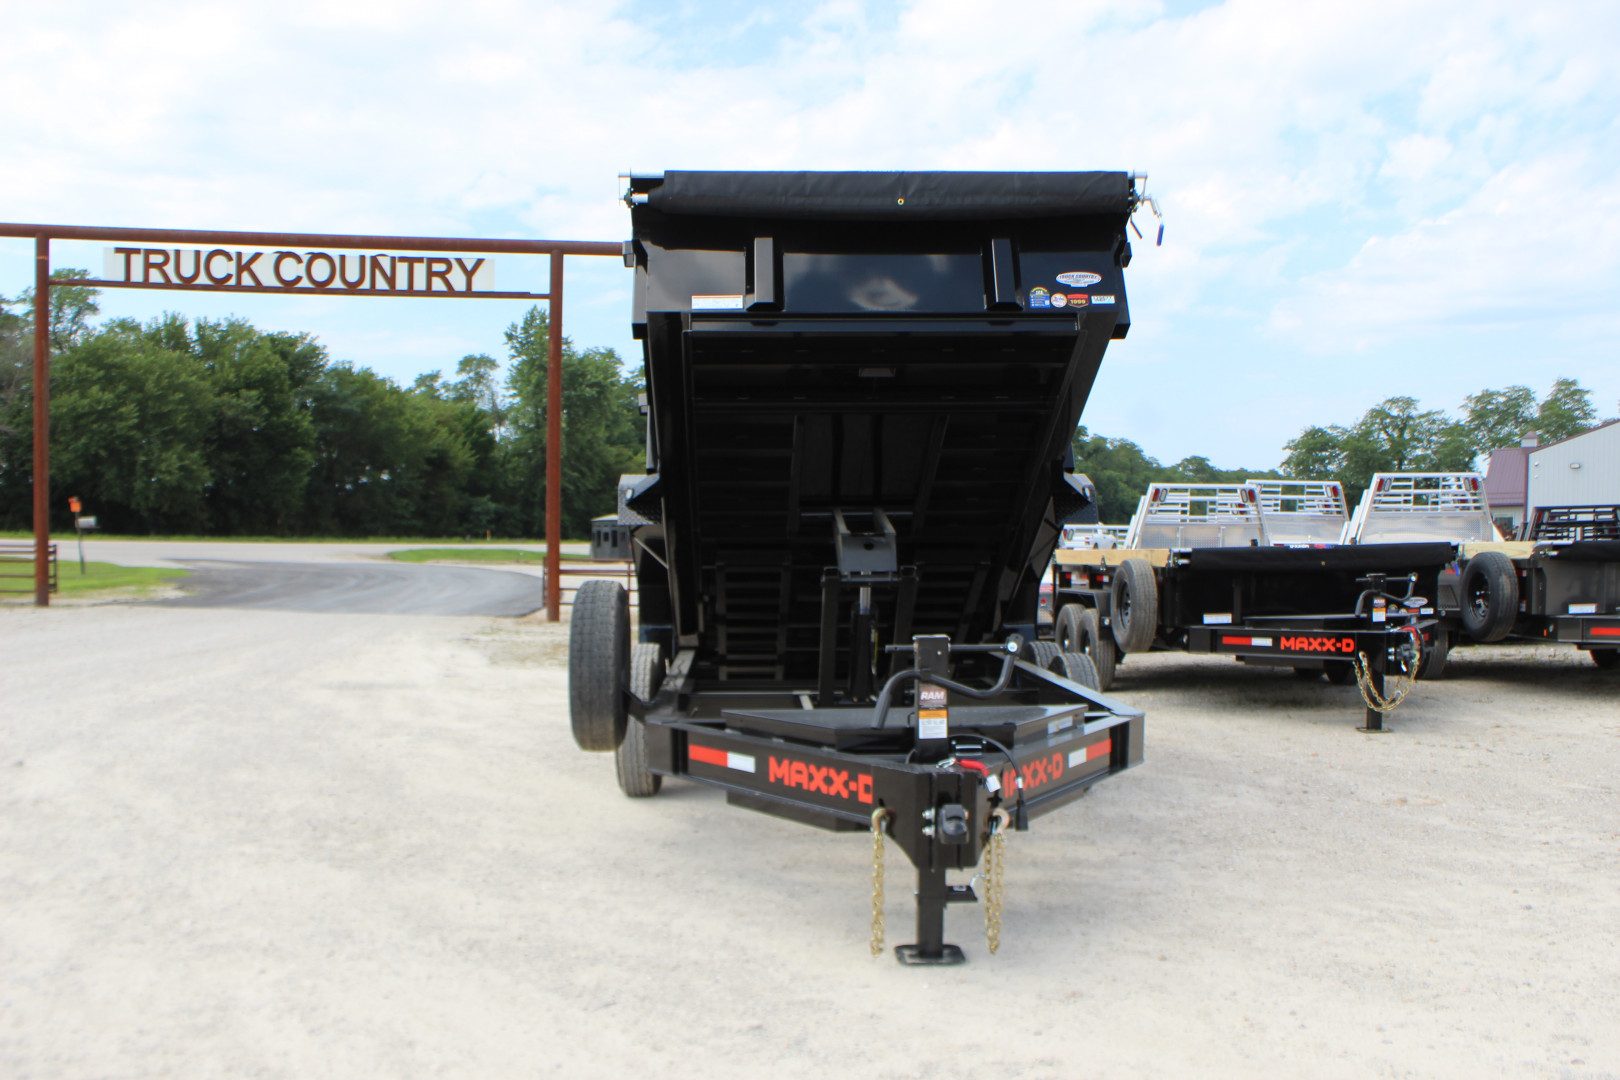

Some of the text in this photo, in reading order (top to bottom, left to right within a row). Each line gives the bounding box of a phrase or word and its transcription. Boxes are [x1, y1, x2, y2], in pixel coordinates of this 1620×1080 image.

[114, 247, 484, 292] TRUCK COUNTRY
[1280, 636, 1355, 653] MAXX-D
[920, 691, 945, 701] RAM
[768, 755, 874, 805] MAXX-D
